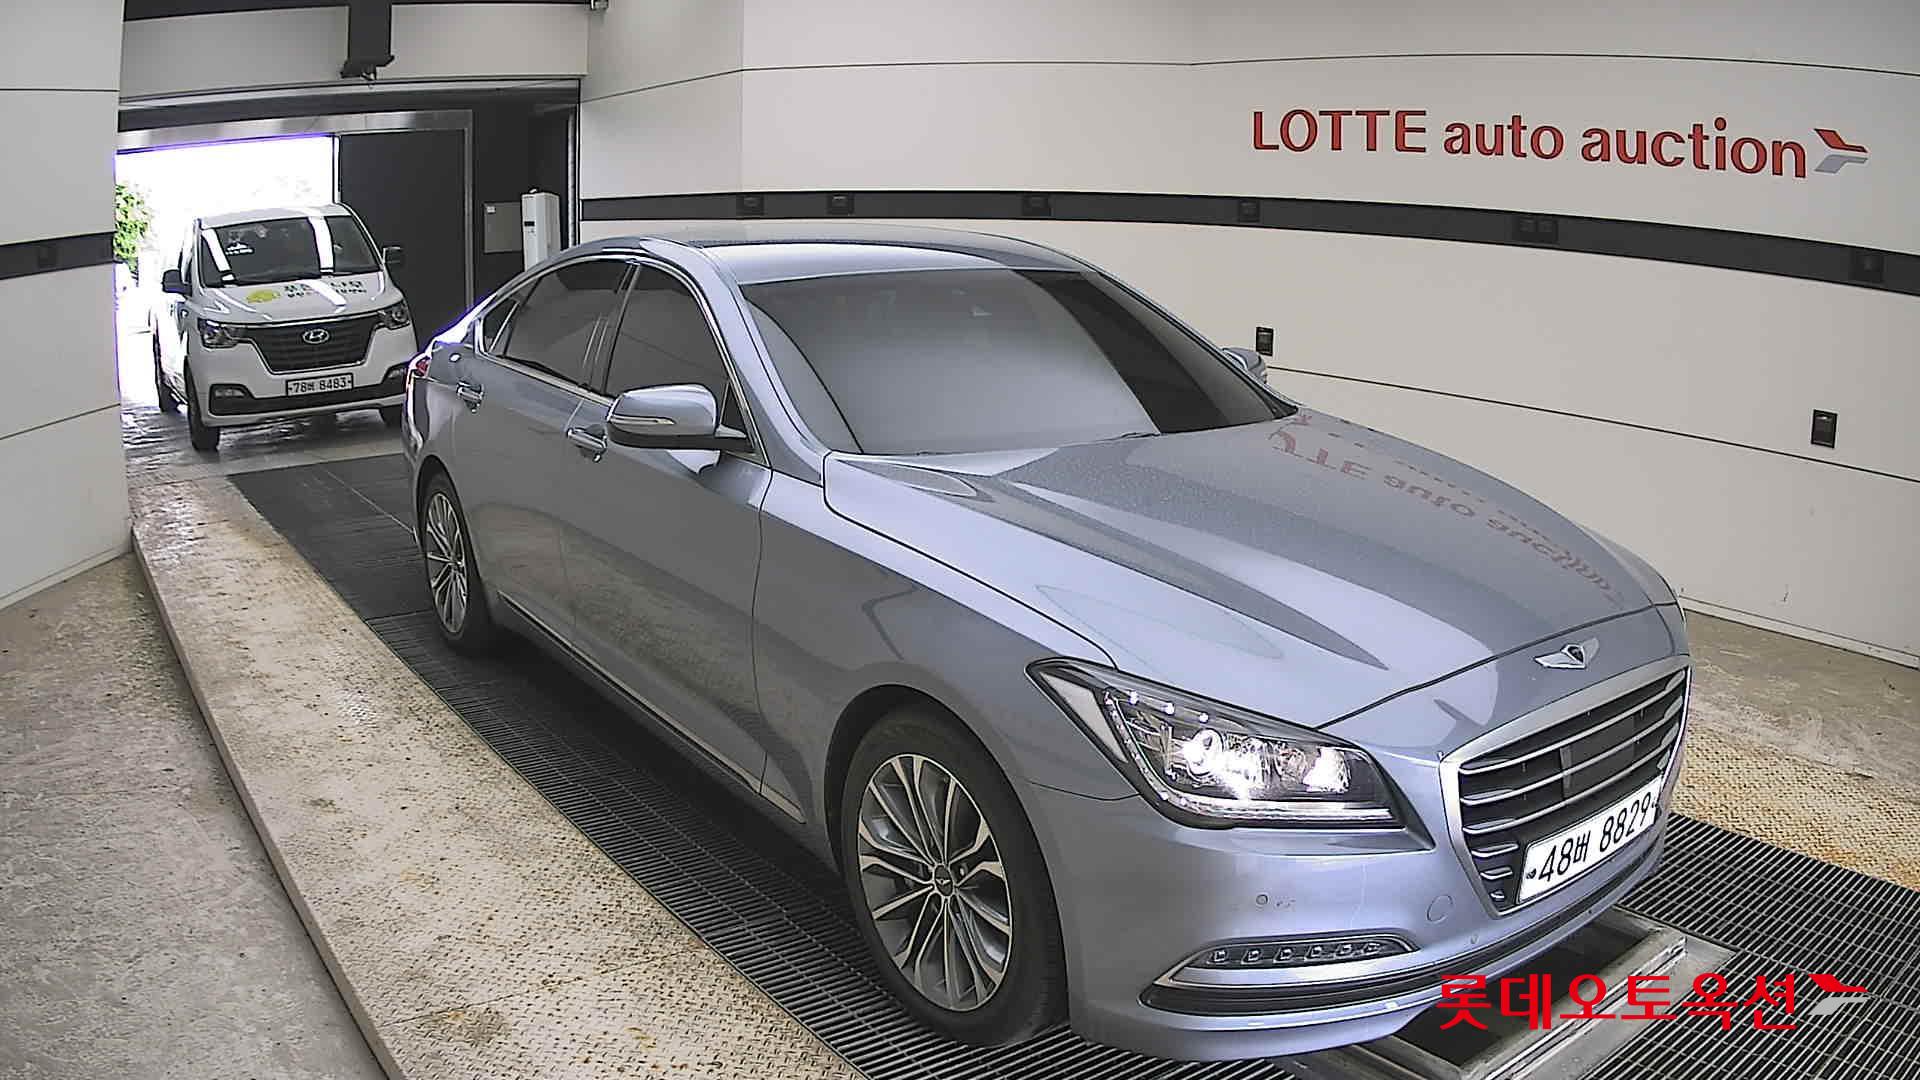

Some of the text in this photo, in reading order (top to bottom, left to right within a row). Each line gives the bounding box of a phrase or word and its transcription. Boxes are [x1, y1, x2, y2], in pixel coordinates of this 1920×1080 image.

[1253, 110, 1807, 178] LOTTE auto auction
[1538, 792, 1652, 882] 48버 8829
